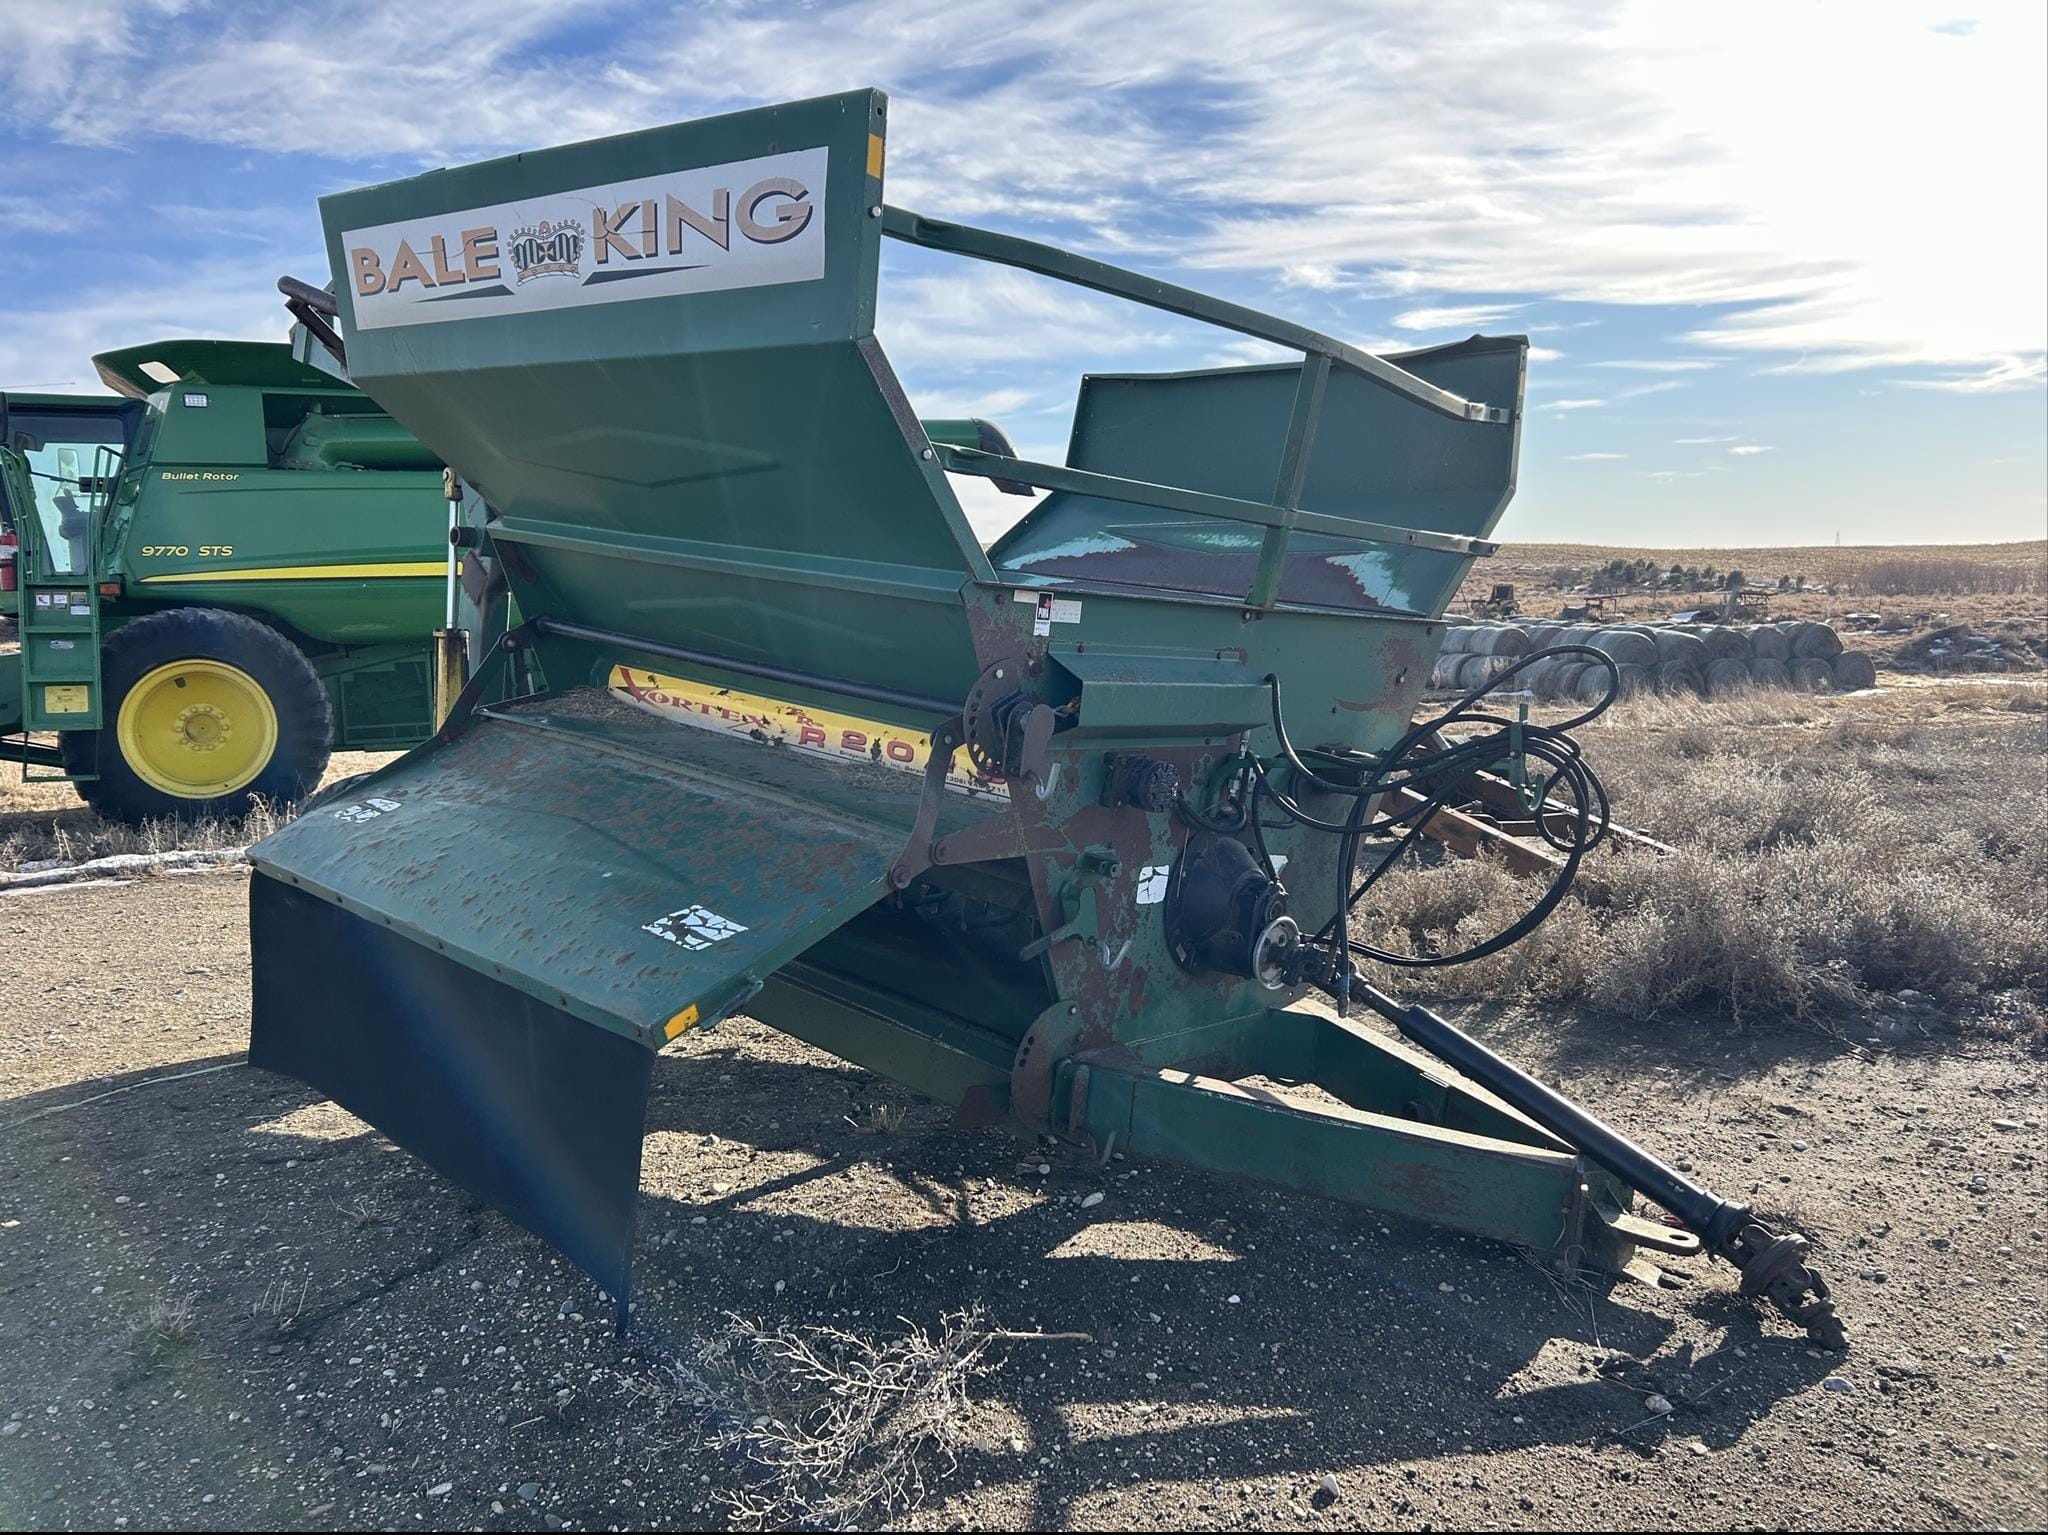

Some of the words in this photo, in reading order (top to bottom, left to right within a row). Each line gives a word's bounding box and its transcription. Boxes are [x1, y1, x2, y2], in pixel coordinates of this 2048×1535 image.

[351, 226, 501, 296] BALE
[592, 177, 814, 265] KING
[161, 472, 200, 480] Bullet
[202, 472, 240, 480] Rotor
[141, 545, 190, 557] 9770
[198, 545, 234, 557] STS
[619, 667, 769, 730] VORTEX
